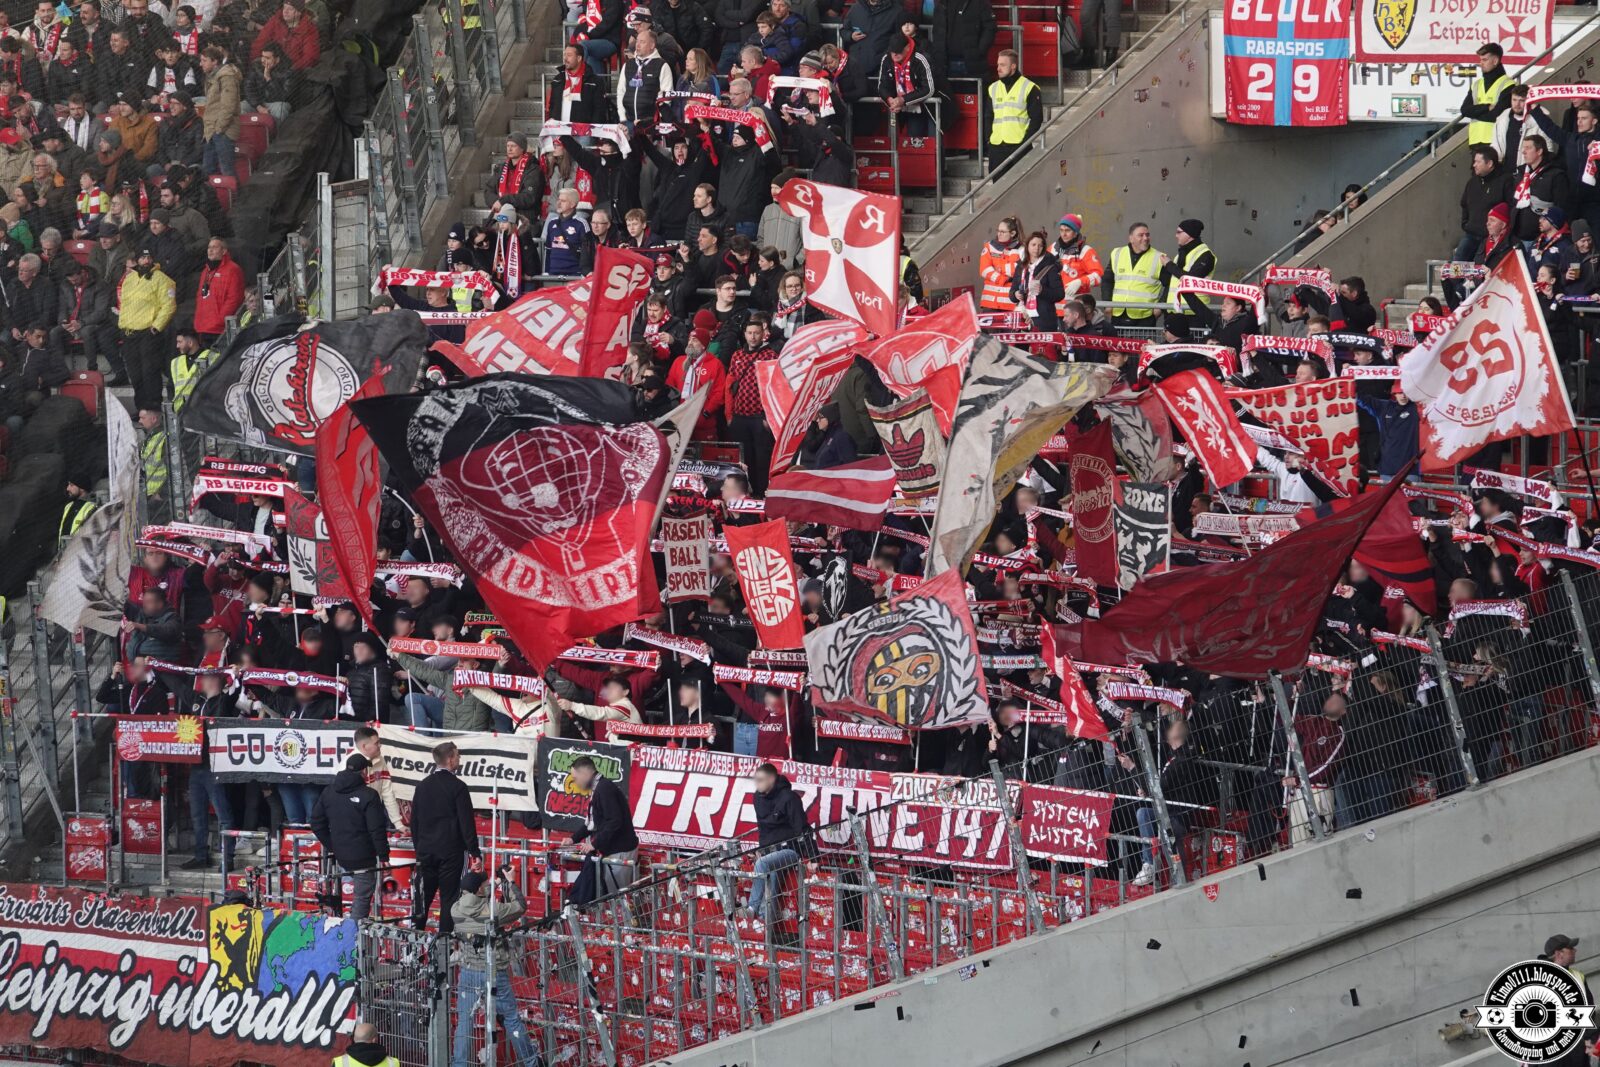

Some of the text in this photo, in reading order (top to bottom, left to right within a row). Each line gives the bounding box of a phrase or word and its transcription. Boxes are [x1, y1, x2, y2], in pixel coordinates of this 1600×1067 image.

[1429, 22, 1491, 45] Leipzig
[1246, 40, 1324, 56] RABASPOS
[1192, 279, 1225, 292] ROTEN
[1226, 282, 1263, 302] BULLEN
[256, 360, 279, 413] ORIGINAL
[336, 366, 354, 400] ORIGI
[210, 462, 268, 475] RB LEIPZIG
[204, 478, 279, 492] RB LEIPZIG
[1124, 486, 1166, 513] ZONE
[663, 520, 705, 542] RASEN
[669, 545, 701, 567] BALL
[736, 545, 787, 580] EINS
[982, 554, 1024, 569] LEIPZIG
[668, 570, 707, 592] SPORT
[438, 641, 501, 658] GENERATION
[563, 647, 628, 662] EIPZIG
[493, 672, 513, 689] RED
[515, 676, 545, 697] PRIDE
[753, 669, 772, 684] RED
[773, 671, 797, 689] PRIDE
[383, 752, 527, 784] rasenallisten
[639, 750, 736, 776] STAY RUDE STAY REBEL
[782, 762, 873, 783] AUSGESPERRTE
[818, 778, 841, 787] NICHT
[892, 776, 936, 803] ZONE
[936, 806, 1009, 861] 147
[157, 953, 357, 1048] überall!
